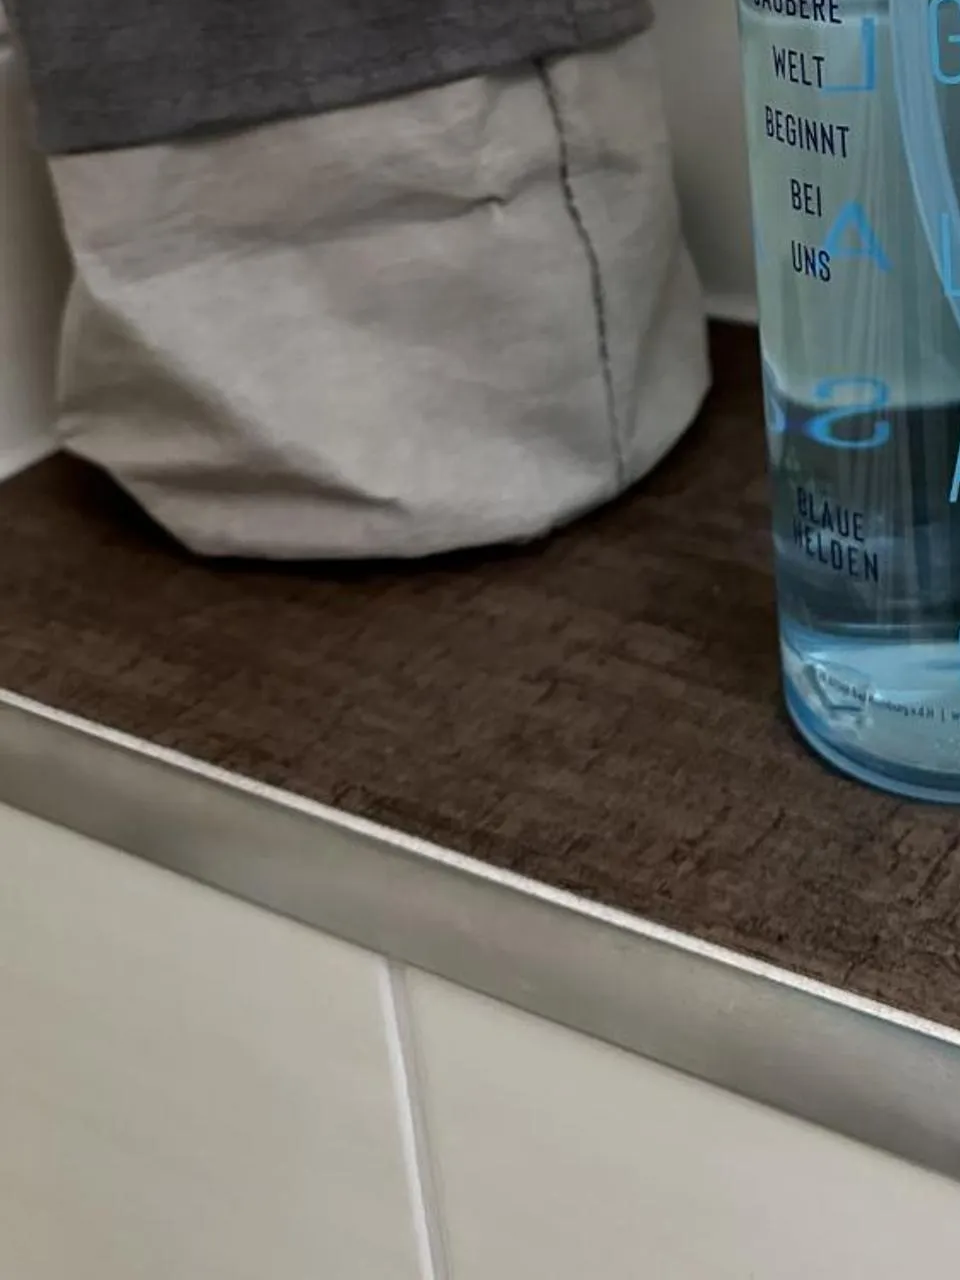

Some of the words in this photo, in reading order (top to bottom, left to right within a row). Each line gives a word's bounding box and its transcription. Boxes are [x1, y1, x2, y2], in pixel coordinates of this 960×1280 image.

[773, 44, 824, 88] WELT
[765, 105, 849, 158] BEGINNT
[791, 179, 822, 217] BEI
[791, 240, 831, 282] UNS
[797, 487, 864, 542] BLAUE
[793, 518, 878, 582] HELDEN
